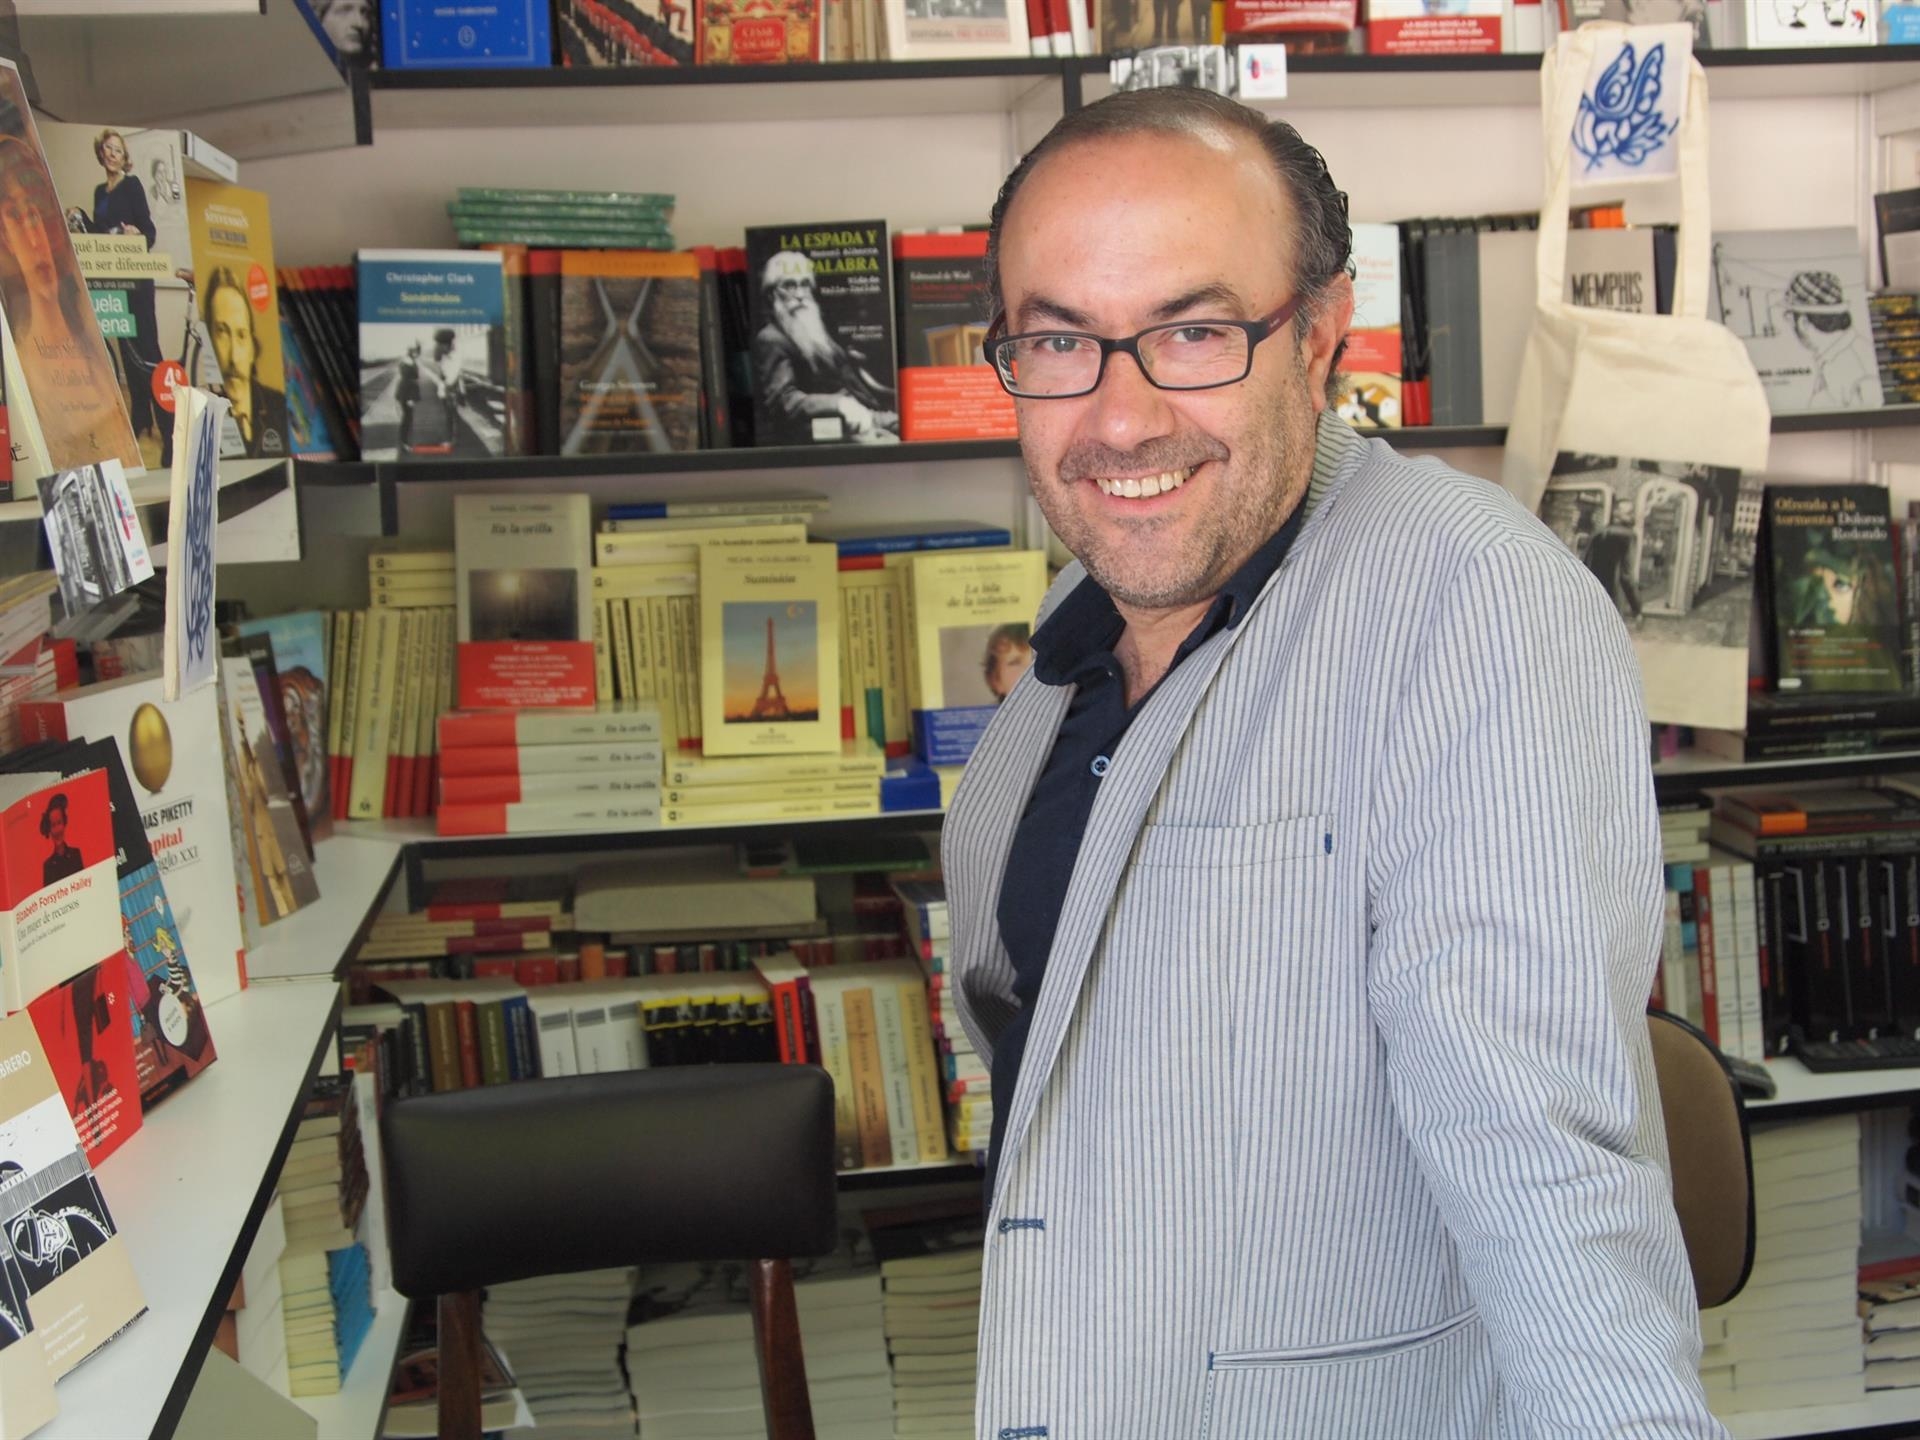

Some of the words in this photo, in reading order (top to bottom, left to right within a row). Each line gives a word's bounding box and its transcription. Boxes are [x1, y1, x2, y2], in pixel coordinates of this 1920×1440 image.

[73, 242, 92, 256] qué
[94, 240, 111, 253] las
[113, 242, 143, 253] cosas
[780, 234, 801, 250] LA
[803, 230, 864, 248] ESPADA
[866, 229, 878, 246] Y
[80, 261, 93, 271] en
[95, 261, 112, 271] ser
[115, 257, 168, 272] diferentes
[782, 260, 801, 274] LA
[806, 256, 879, 274] PALABRA
[385, 271, 444, 284] Christopher
[447, 272, 475, 284] Clark
[909, 270, 942, 281] Edmund
[1572, 272, 1643, 306] MEMPHIS
[95, 293, 123, 313] uela
[101, 318, 130, 334] ena
[1831, 527, 1888, 541] Redondo
[160, 799, 193, 825] PIKETTY
[152, 826, 183, 856] pital
[38, 887, 69, 908] Forsythe
[0, 1050, 32, 1079] BRERO
